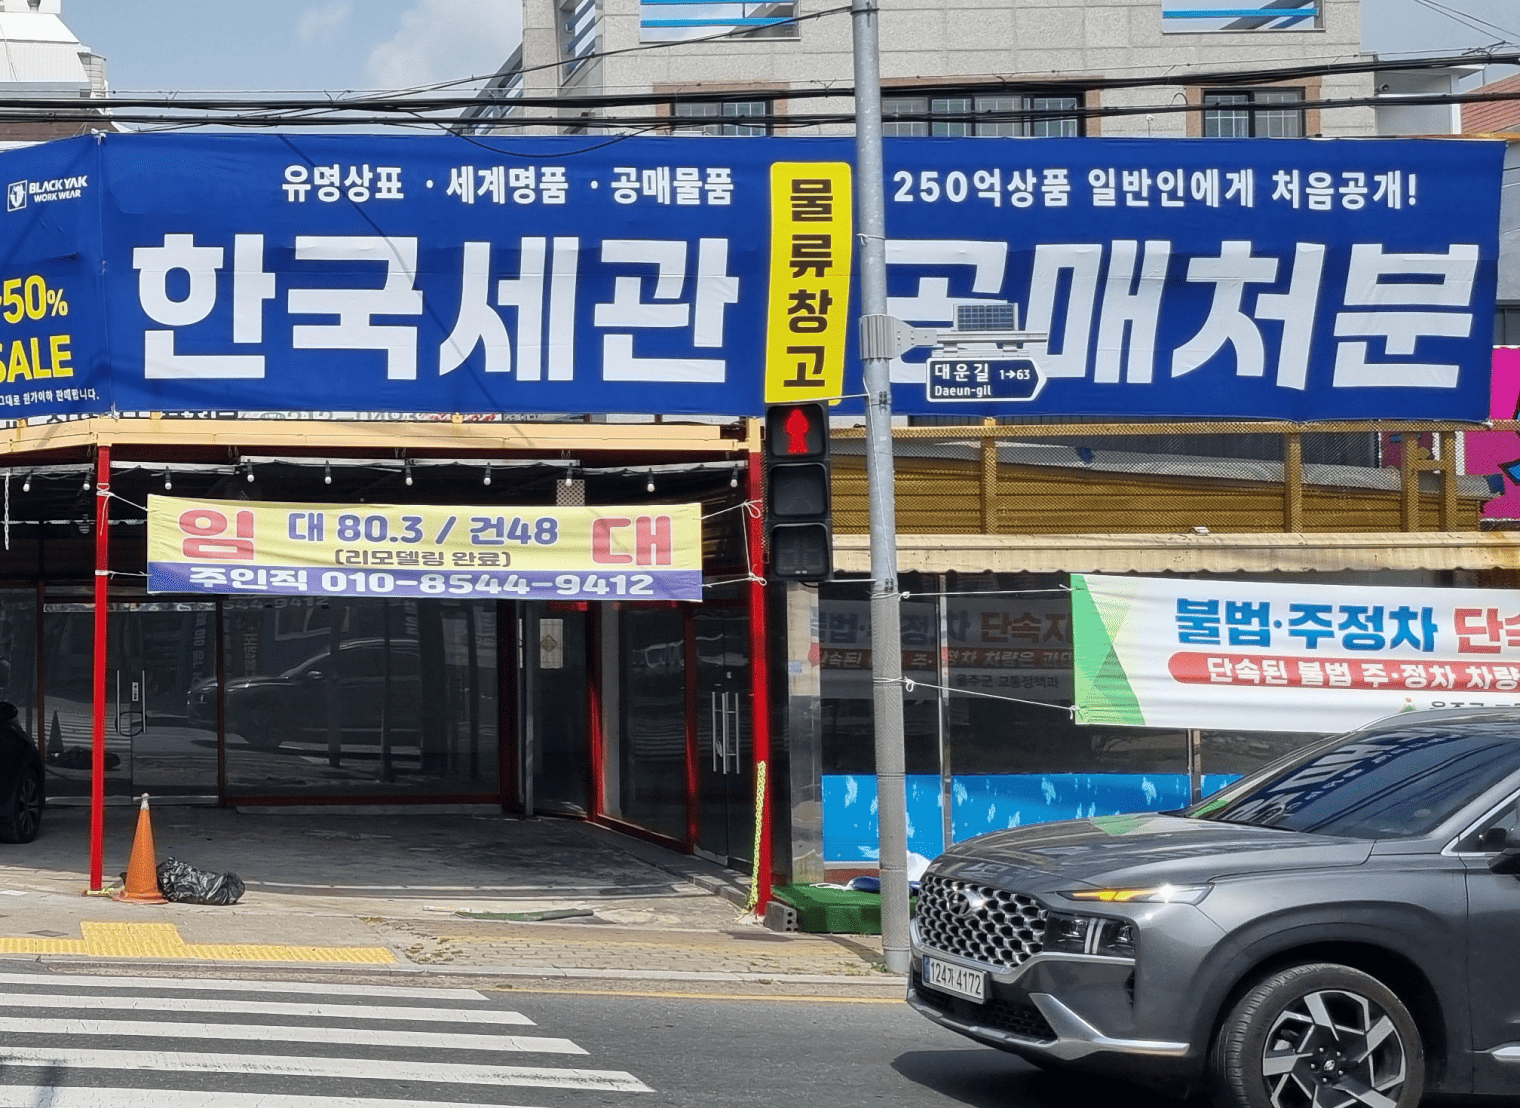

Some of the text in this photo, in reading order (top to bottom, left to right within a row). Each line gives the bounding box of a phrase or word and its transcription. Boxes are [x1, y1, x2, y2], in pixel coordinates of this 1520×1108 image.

[33, 189, 82, 203] WORK WEAR
[281, 164, 734, 206] 유명상표 세계명품 공매물품
[893, 168, 1419, 211] 250억상품 일반인에게 처음공개!
[783, 178, 835, 390] 물류창고
[132, 233, 740, 382] 한국세관
[884, 239, 1480, 391] 공매처분
[934, 363, 989, 382] 대운길
[23, 389, 54, 405] 원가이하
[934, 384, 992, 398] Daeun-gil
[179, 508, 672, 567] 임 대
[287, 511, 324, 545] 대
[336, 514, 424, 546] 80.3
[469, 517, 559, 547] 건48
[334, 548, 512, 568] (리모델링 완료)
[188, 565, 655, 597] 주인직 010-8544-9412
[1175, 597, 1439, 653] 불법·주정차
[1207, 658, 1520, 691] 단속된 불법 주·정차 차량
[930, 961, 982, 996] 124가 4172
